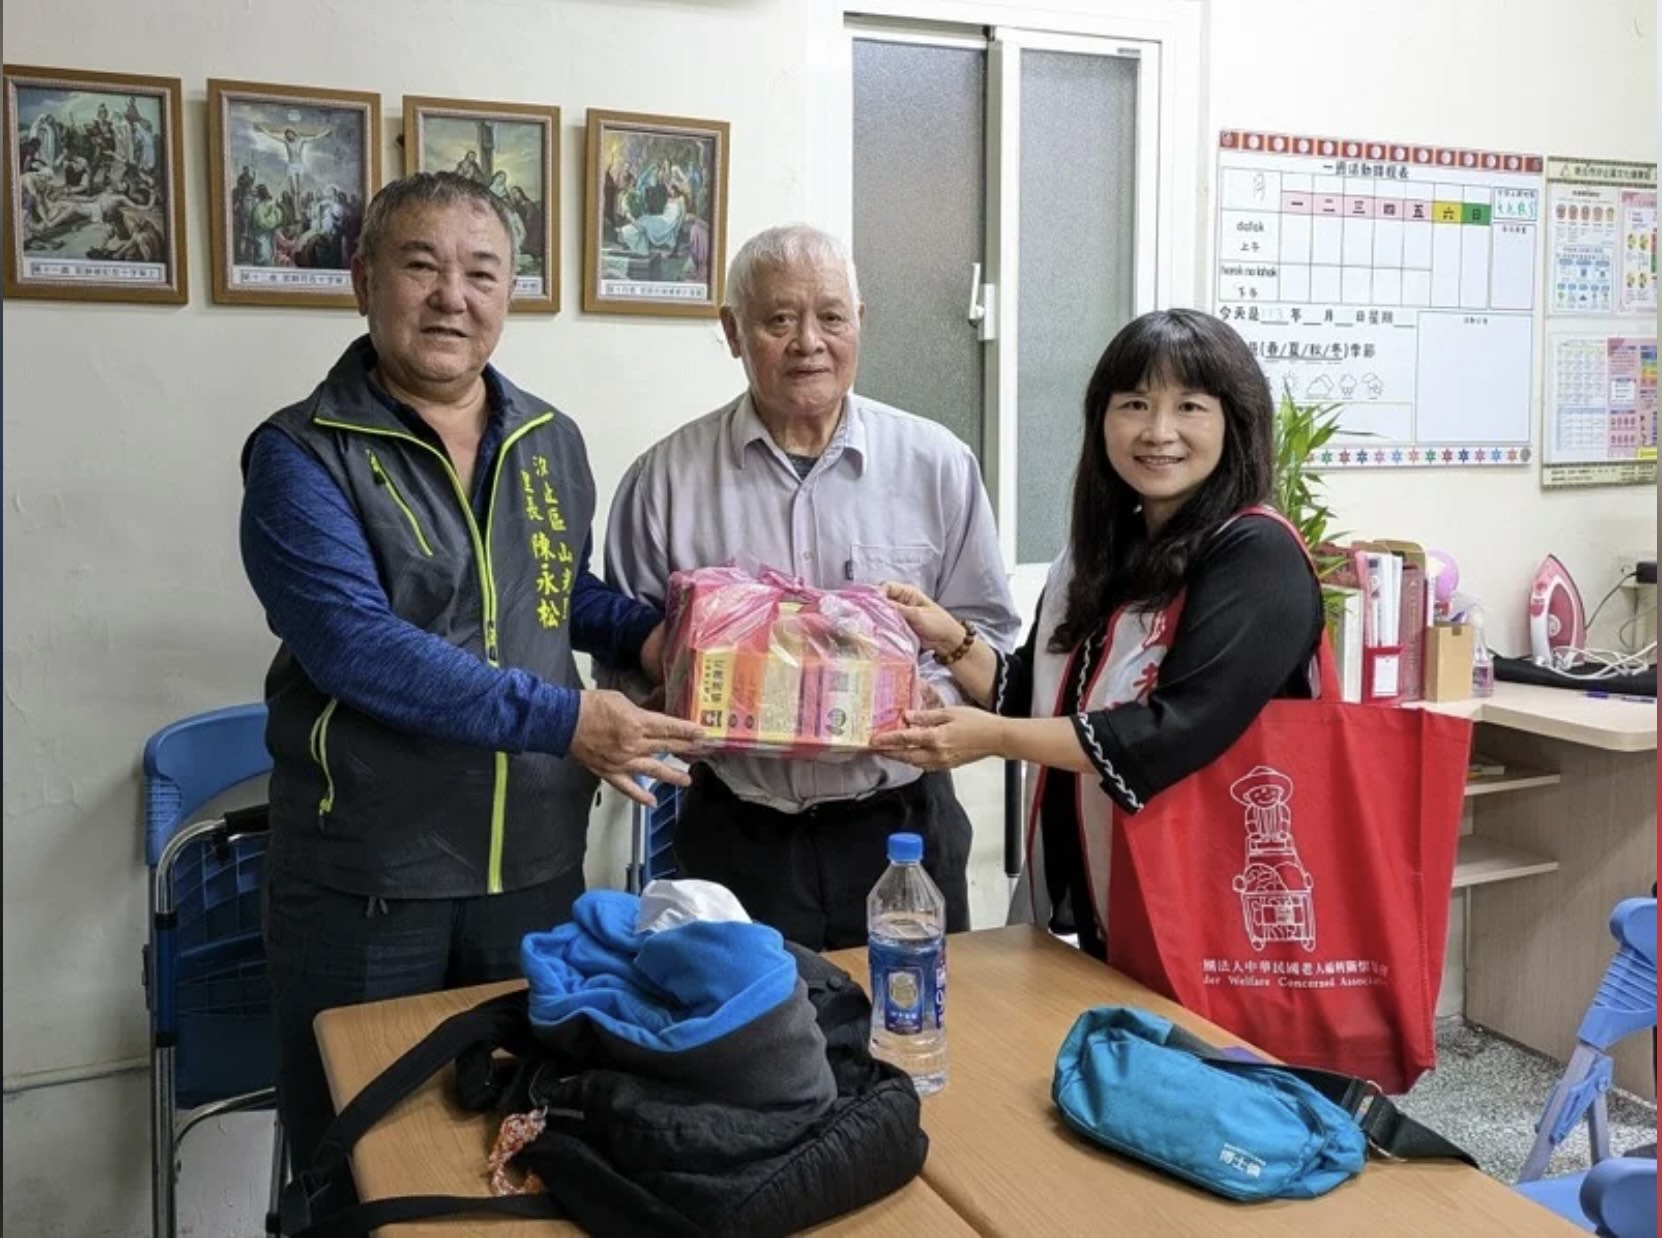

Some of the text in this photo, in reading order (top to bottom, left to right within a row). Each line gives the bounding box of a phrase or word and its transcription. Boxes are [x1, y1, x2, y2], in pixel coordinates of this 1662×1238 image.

[1323, 199, 1336, 213] 二
[1352, 200, 1366, 215] 三
[1383, 203, 1396, 216] 四
[1412, 204, 1425, 219] 五
[1443, 207, 1455, 221] 六
[1471, 207, 1482, 221] 日
[1219, 305, 1260, 322] 今天是
[1291, 308, 1301, 322] 年
[1325, 309, 1334, 323] 月
[531, 531, 561, 629] 陳永松
[1227, 974, 1271, 987] Welfare
[1277, 975, 1335, 989] Concerned
